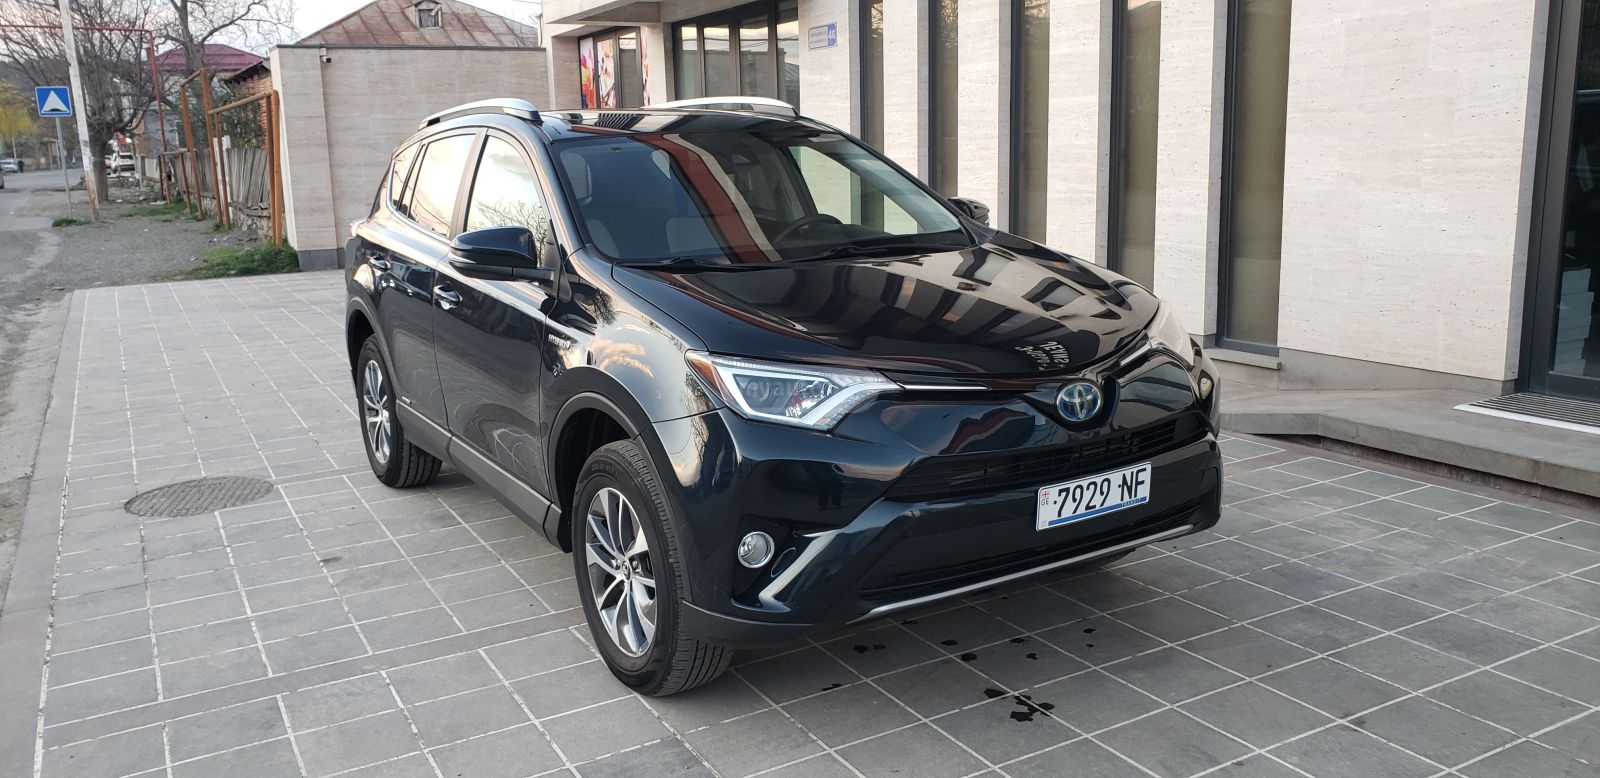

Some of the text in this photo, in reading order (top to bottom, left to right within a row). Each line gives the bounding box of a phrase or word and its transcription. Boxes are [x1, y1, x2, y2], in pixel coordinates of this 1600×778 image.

[1041, 498, 1050, 506] GE
[1057, 467, 1147, 518] 7929 NF
